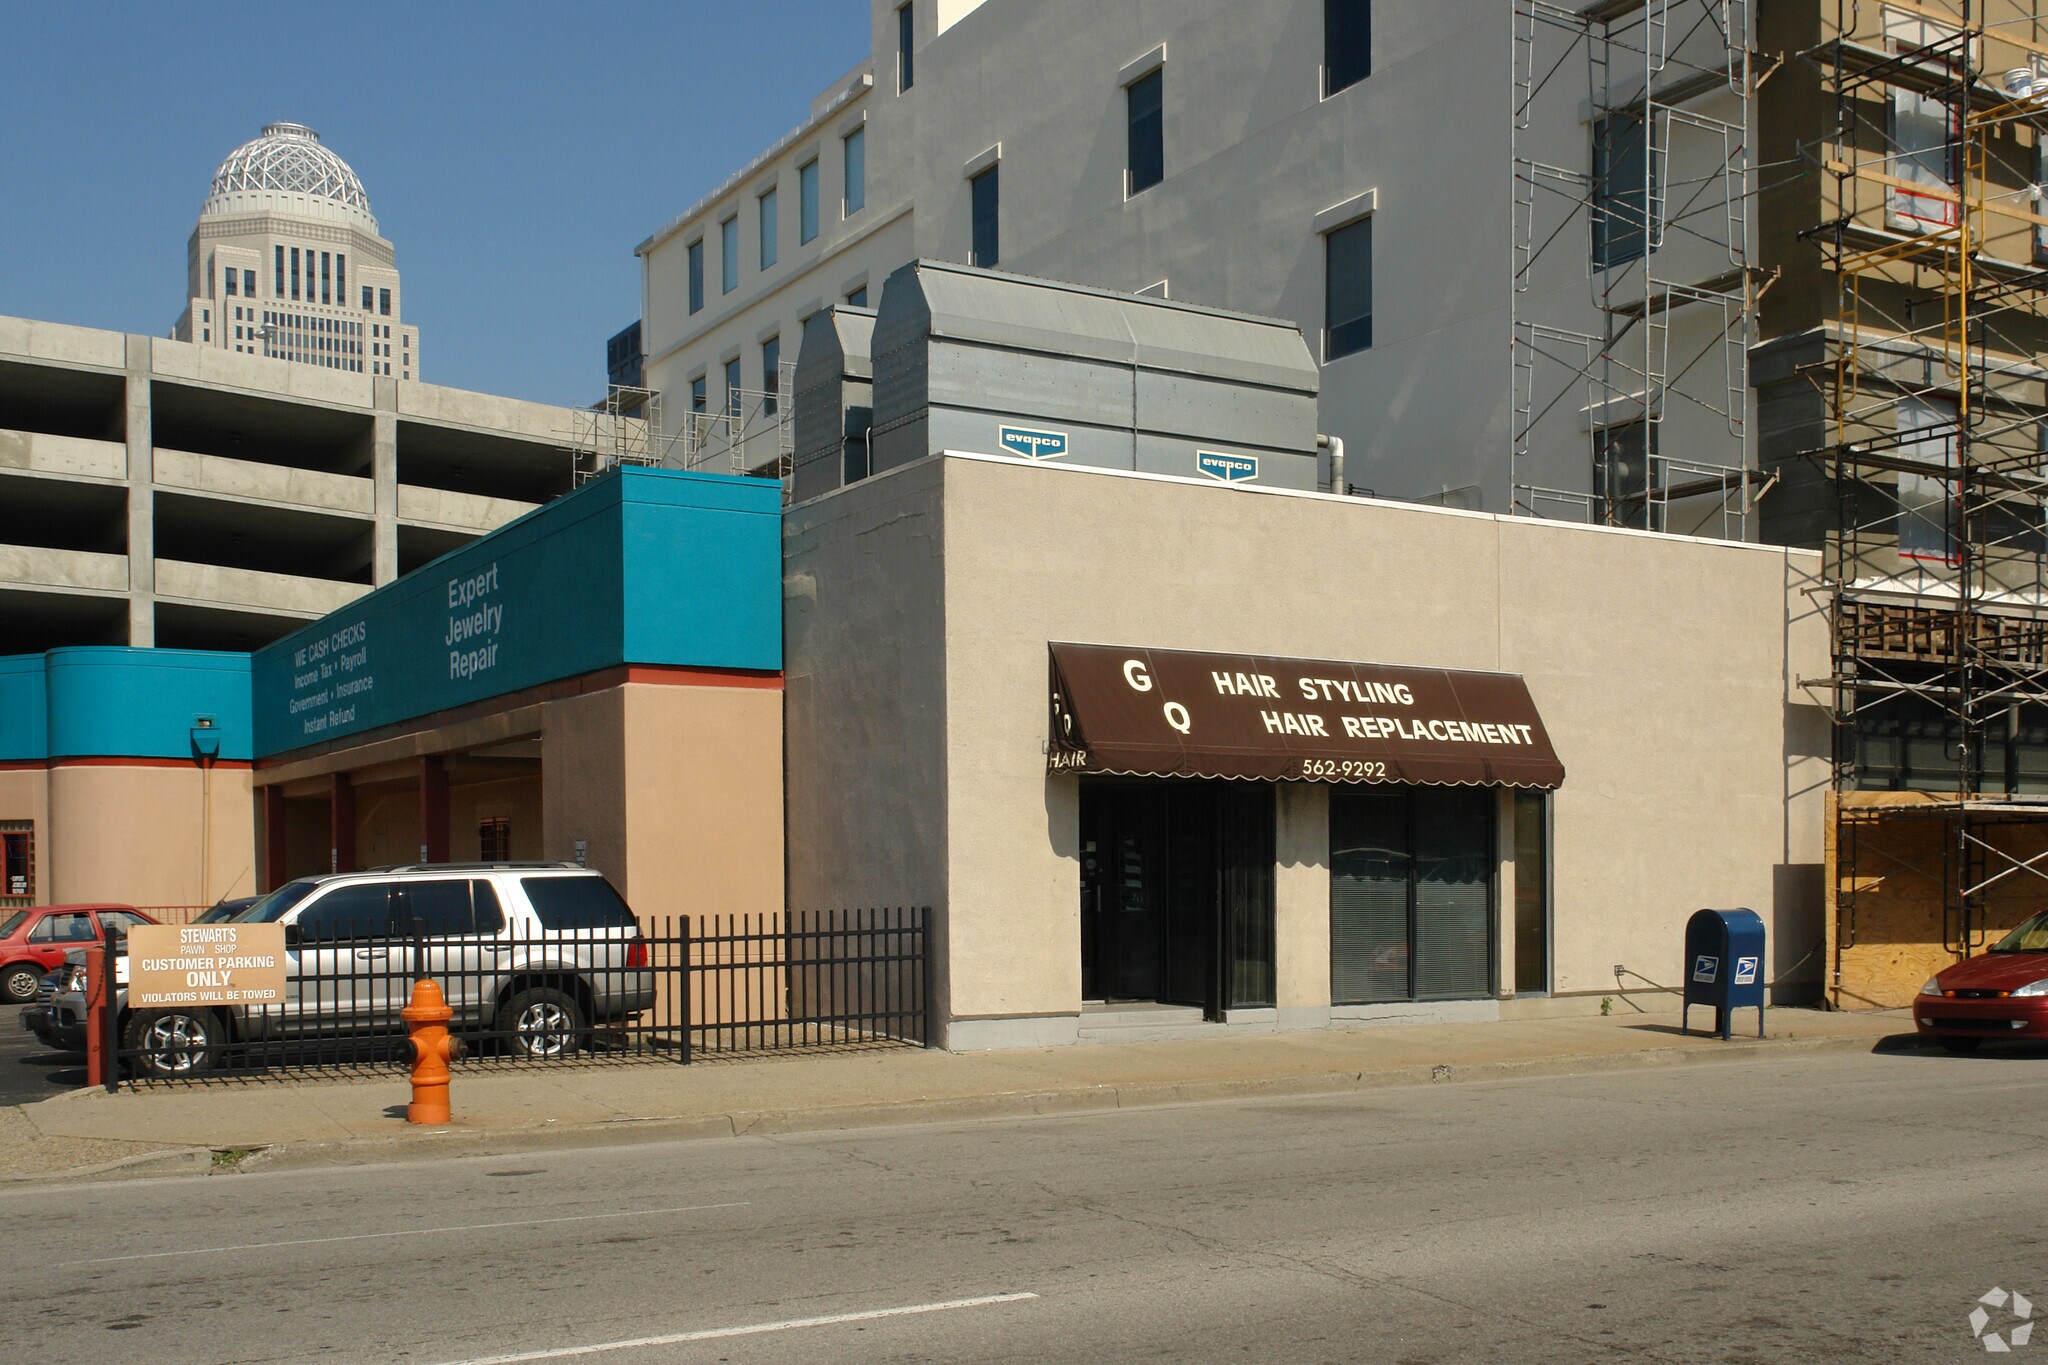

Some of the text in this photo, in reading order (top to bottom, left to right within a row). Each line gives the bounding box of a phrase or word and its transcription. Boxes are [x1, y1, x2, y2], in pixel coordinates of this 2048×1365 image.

[1006, 433, 1060, 447] evapco
[1203, 458, 1251, 471] evapco
[449, 562, 498, 608] Expert
[446, 603, 503, 646] Jewelry
[295, 621, 366, 668] WE CASH CHECKS
[450, 639, 498, 680] Repair
[295, 649, 366, 689] Income Tax Payroll
[1123, 659, 1153, 692] G
[290, 675, 373, 714] Government Insurance
[1212, 671, 1414, 706] HAIR STYLING
[304, 704, 355, 734] Instant Refund
[1163, 701, 1192, 735] Q
[1260, 710, 1531, 746] HAIR REPLACEMENT
[1049, 751, 1087, 768] HAIR
[1302, 759, 1386, 777] 562-9292
[180, 928, 236, 943] STEWART'S
[181, 945, 236, 954] PAWN SHOP
[142, 956, 275, 971] CUSTOMER PARKING
[187, 971, 231, 987] ONLY
[142, 992, 196, 1002] VIOLATORS
[200, 991, 223, 1000] WILL
[227, 991, 239, 1000] BE
[242, 990, 276, 999] TOWED
